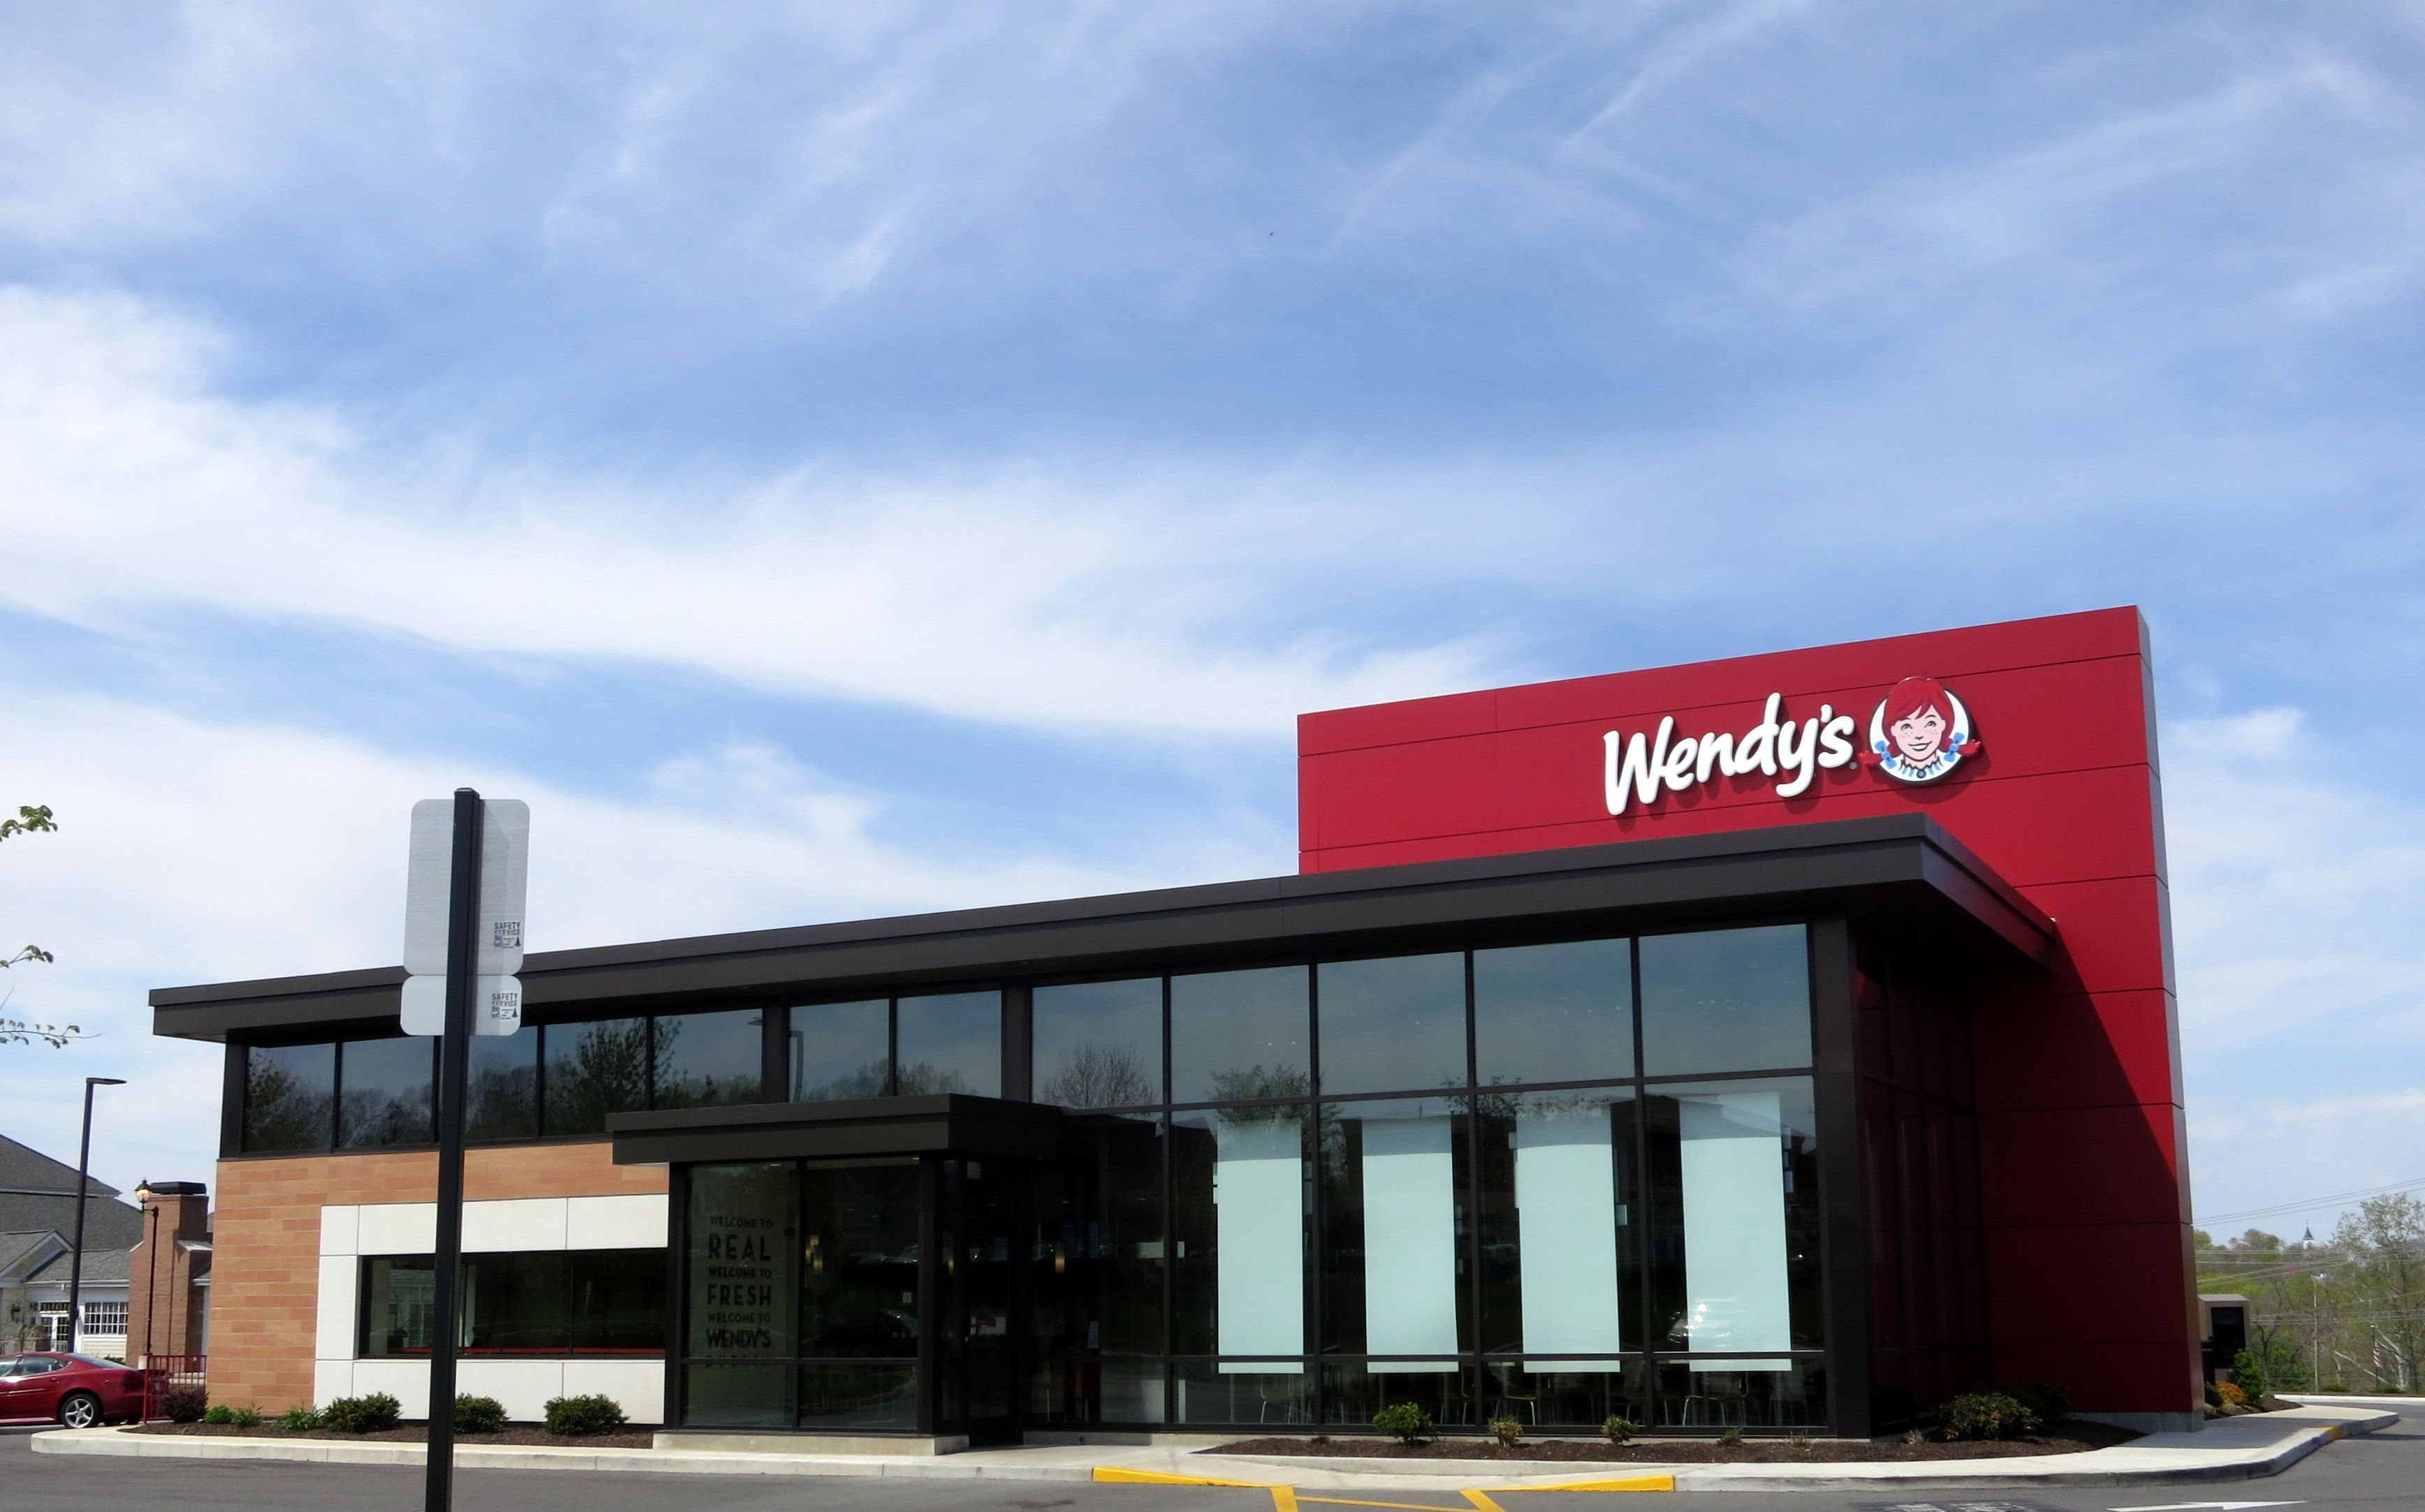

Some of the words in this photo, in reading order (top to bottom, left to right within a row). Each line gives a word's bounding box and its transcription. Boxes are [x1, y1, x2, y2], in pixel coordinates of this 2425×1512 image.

[1603, 692, 1855, 816] Wendy's
[710, 1216, 757, 1229] WELCOME
[761, 1219, 772, 1229] TO
[708, 1233, 771, 1261] REAL
[708, 1267, 756, 1279] WELCOME
[759, 1268, 772, 1279] TO
[707, 1284, 771, 1307] FRESH
[708, 1312, 755, 1323] WELCOME
[759, 1312, 771, 1323] TO
[705, 1328, 771, 1349] WENDY'S
